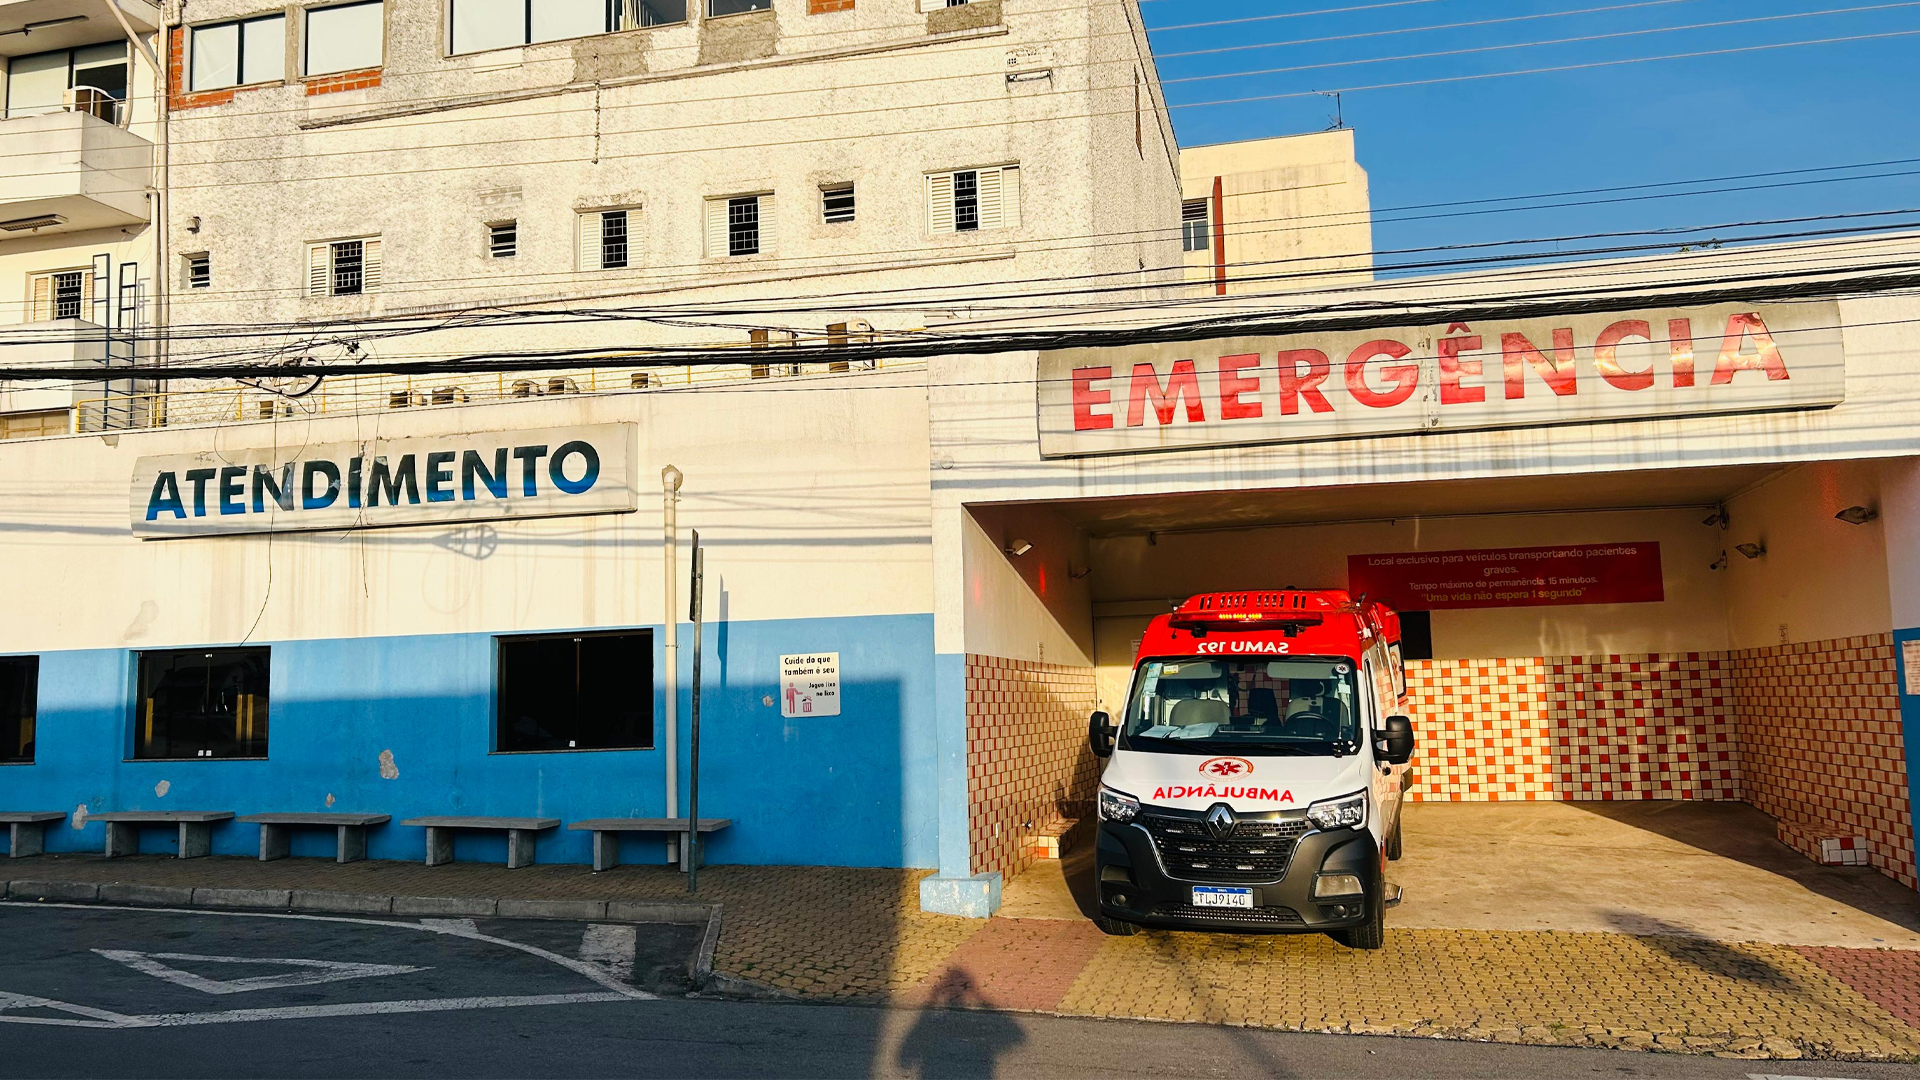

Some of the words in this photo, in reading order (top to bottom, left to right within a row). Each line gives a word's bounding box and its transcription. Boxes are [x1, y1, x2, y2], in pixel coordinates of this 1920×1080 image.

[1071, 312, 1791, 431] EMERGÊNCIA
[145, 439, 601, 522] ATENDIMENTO
[1368, 556, 1394, 566] Local
[1396, 555, 1440, 565] exclusivo
[1442, 554, 1464, 565] para
[1466, 552, 1507, 562] veículos
[1509, 548, 1583, 561] transportando
[1586, 546, 1637, 559] pacientes
[1483, 565, 1519, 576] graves.
[1409, 582, 1438, 591] Tempo
[1440, 580, 1474, 590] máximo
[1475, 579, 1487, 588] de
[1489, 577, 1546, 589] permanência:
[1548, 577, 1557, 585] 15
[1559, 575, 1599, 585] minutos.
[1451, 592, 1472, 601] vida
[1473, 591, 1493, 600] não
[1495, 590, 1529, 601] espera
[1531, 590, 1536, 598] 1
[784, 656, 804, 665] Cuide
[806, 656, 815, 664] do
[817, 656, 831, 665] que
[784, 667, 814, 676] também
[816, 666, 820, 674] é
[1199, 893, 1245, 905] TLJ9140
